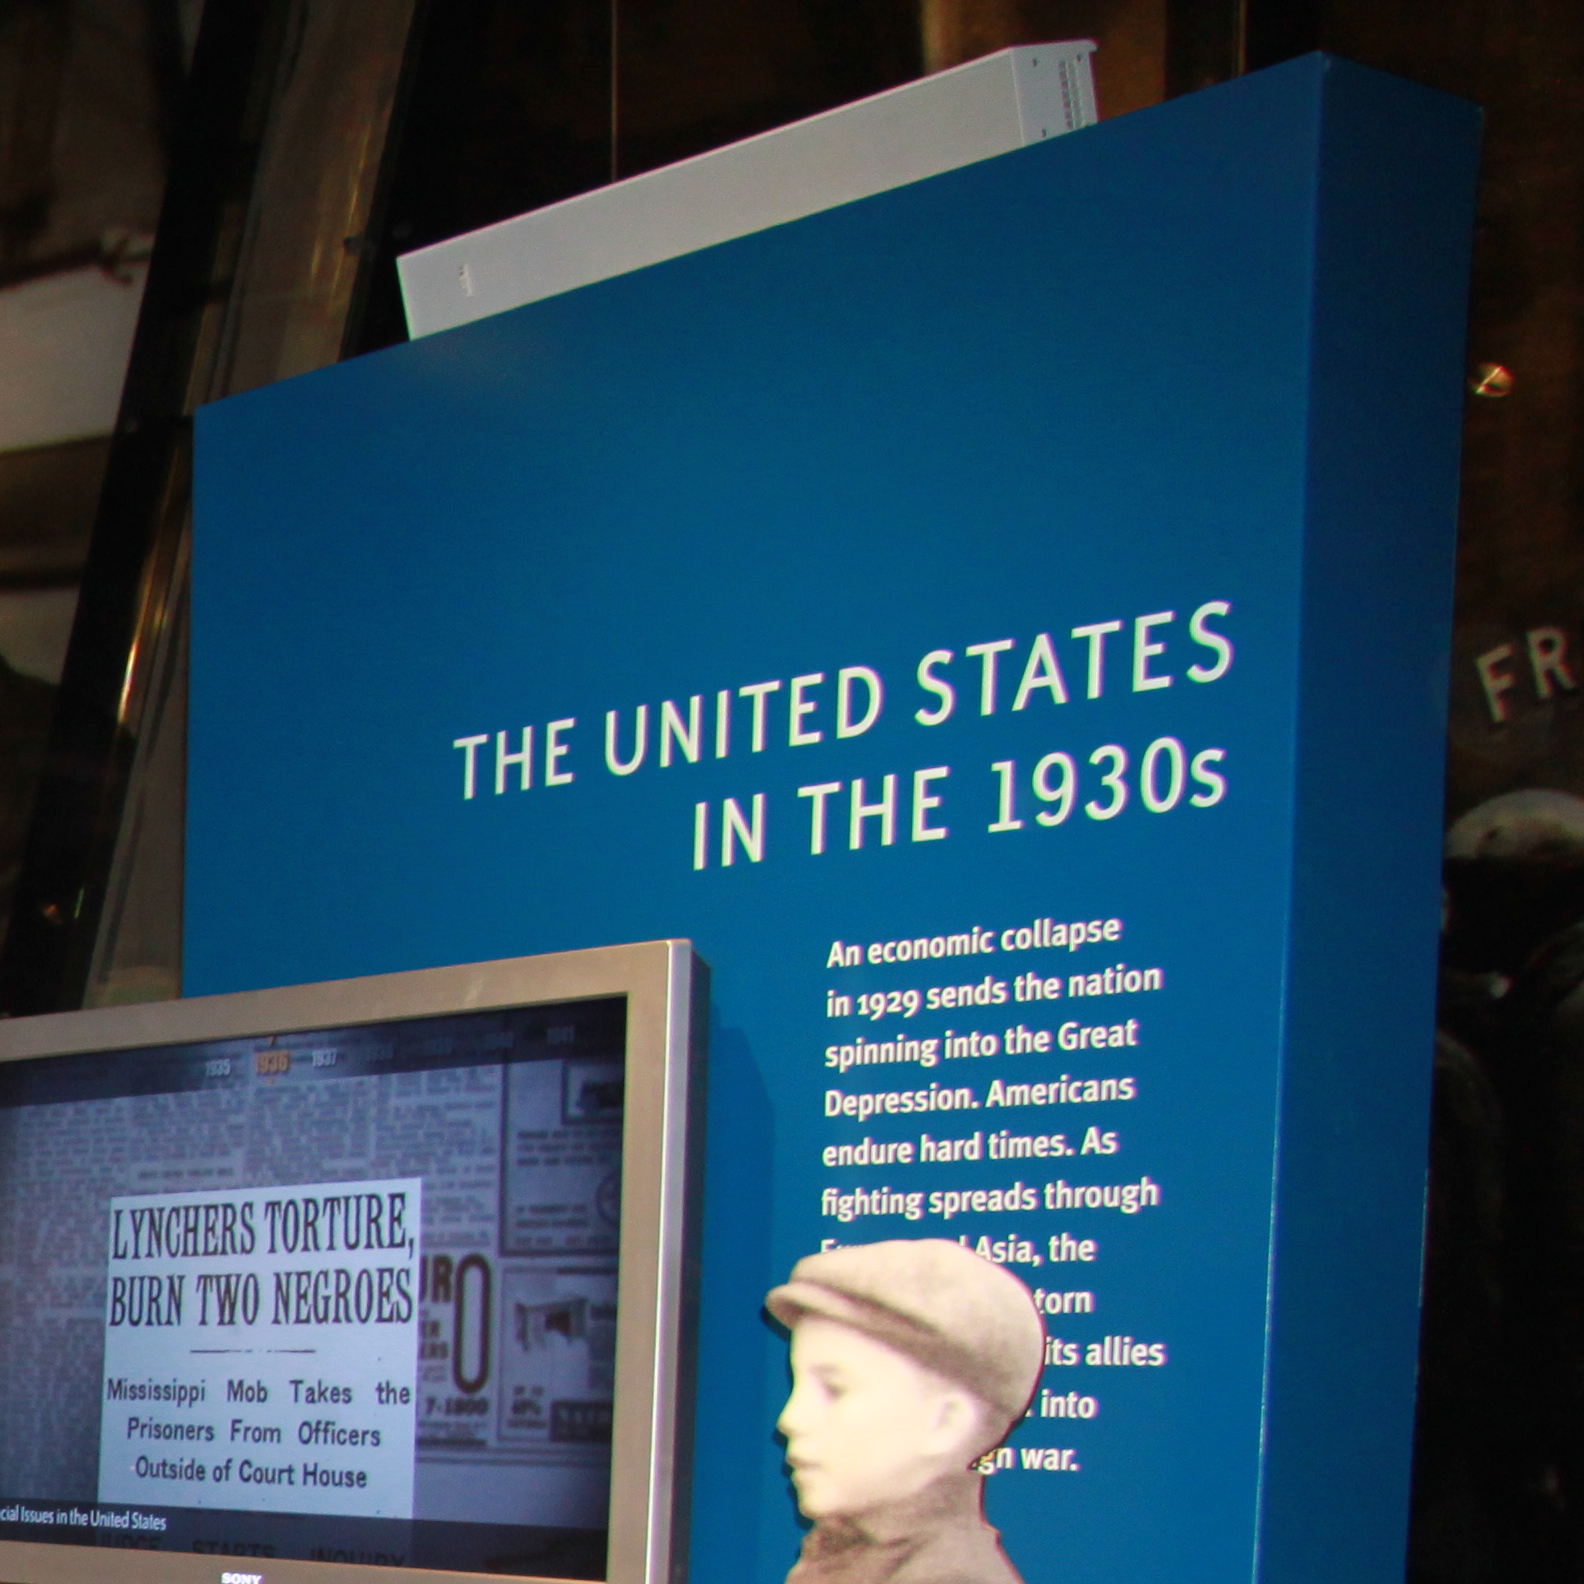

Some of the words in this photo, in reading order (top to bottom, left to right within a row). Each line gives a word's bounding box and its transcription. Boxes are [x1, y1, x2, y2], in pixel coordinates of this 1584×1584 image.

[453, 717, 575, 800] THE
[605, 665, 882, 776] UNITED
[915, 600, 1232, 726] STATES
[694, 793, 764, 870] IN
[797, 765, 949, 855] THE
[988, 736, 1226, 833] 1930s
[826, 940, 862, 969] An
[867, 926, 994, 964] economic
[1001, 917, 1122, 952] collapse
[827, 989, 851, 1018] in
[857, 989, 920, 1021] 1929
[926, 975, 1008, 1010] sends
[1013, 971, 1062, 1002] the
[1069, 963, 1162, 998] nation
[825, 1033, 939, 1074] spinning
[945, 1029, 999, 1059] into
[1004, 1024, 1051, 1055] the
[1057, 1018, 1139, 1051] Great
[825, 1082, 980, 1123] Depression.
[985, 1074, 1136, 1108] Americans
[822, 1137, 914, 1167] endure
[920, 1131, 982, 1162] hard
[988, 1129, 1074, 1160] times.
[1080, 1126, 1118, 1155] As
[821, 1186, 924, 1222] fighting
[928, 1181, 1038, 1220] spreads
[1044, 1176, 1160, 1214] through
[112, 1201, 256, 1260] LYNCHERS
[264, 1192, 415, 1258] TORTURE,
[974, 1235, 1043, 1267] Asia,
[1049, 1232, 1097, 1262] the
[109, 1274, 186, 1327] BURN
[196, 1272, 260, 1326] TWO
[271, 1267, 413, 1325] NEGROES
[1045, 1336, 1078, 1366] its
[1085, 1336, 1167, 1367] allies
[107, 1377, 206, 1408] Mississippi
[227, 1379, 269, 1404] Mob
[289, 1379, 353, 1405] Takes
[375, 1380, 411, 1405] the
[1040, 1389, 1099, 1418] into
[127, 1416, 216, 1442] Prisoners
[230, 1418, 282, 1444] From
[298, 1419, 381, 1447] Officers
[135, 1454, 207, 1482] Outside
[212, 1458, 233, 1483] of
[238, 1459, 295, 1486] Court
[302, 1462, 368, 1489] House
[1020, 1447, 1080, 1471] war.
[20, 1506, 55, 1524] Issues
[56, 1512, 68, 1525] in
[69, 1508, 89, 1526] the
[90, 1510, 130, 1529] United
[131, 1512, 167, 1531] States
